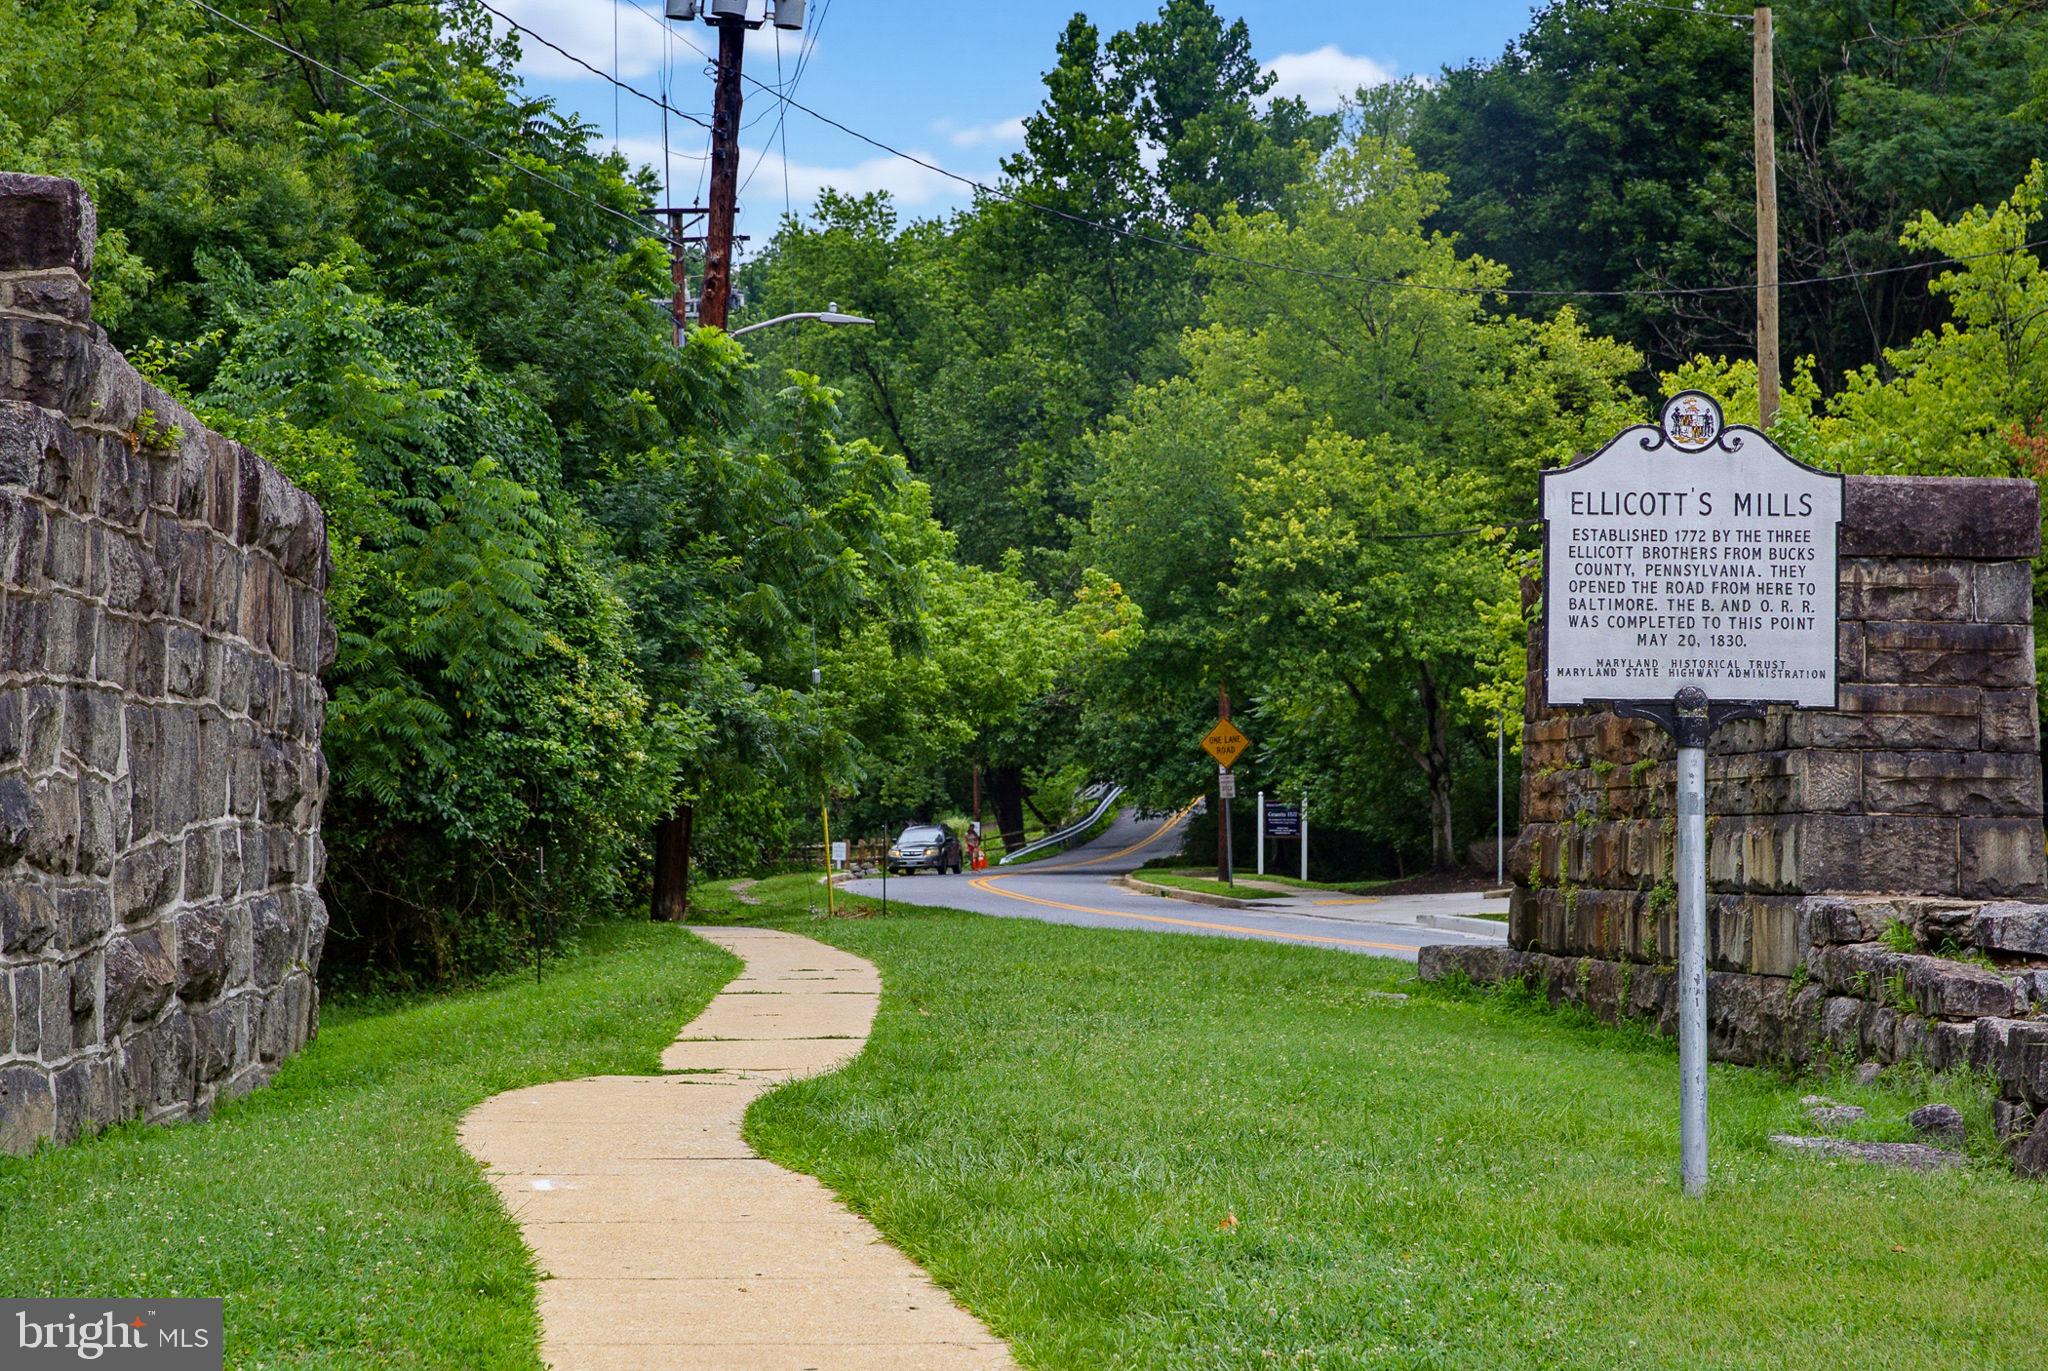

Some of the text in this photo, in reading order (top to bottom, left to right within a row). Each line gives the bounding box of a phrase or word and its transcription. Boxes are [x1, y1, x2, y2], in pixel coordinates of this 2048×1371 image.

[1571, 487, 1812, 517] ELLICOTT'S MILLS
[1572, 528, 1811, 543] ESTABLISHED 1772 BY THE THREE
[1568, 546, 1815, 560] ELLICOTT BROTHERS FROM BUCKS
[1575, 563, 1806, 578] COUNTY, PENNSYLVANIA. THEY
[1569, 580, 1816, 595] OPENED THE ROAD FROM HERE TO
[1569, 598, 1815, 613] BALTIMORE. THE B. AND O. R. R.
[1568, 615, 1815, 630] WAS COMPLETED TO THIS POINT
[1637, 633, 1747, 648] MAY 20, 1830.
[1596, 658, 1786, 669] MARYLAND HISTORICAL TRUST
[1557, 667, 1826, 679] MARYLAND STATE HIGHWAY ADMINISTRATION
[1209, 735, 1241, 744] ONE LANE
[1216, 746, 1236, 754] ROAD
